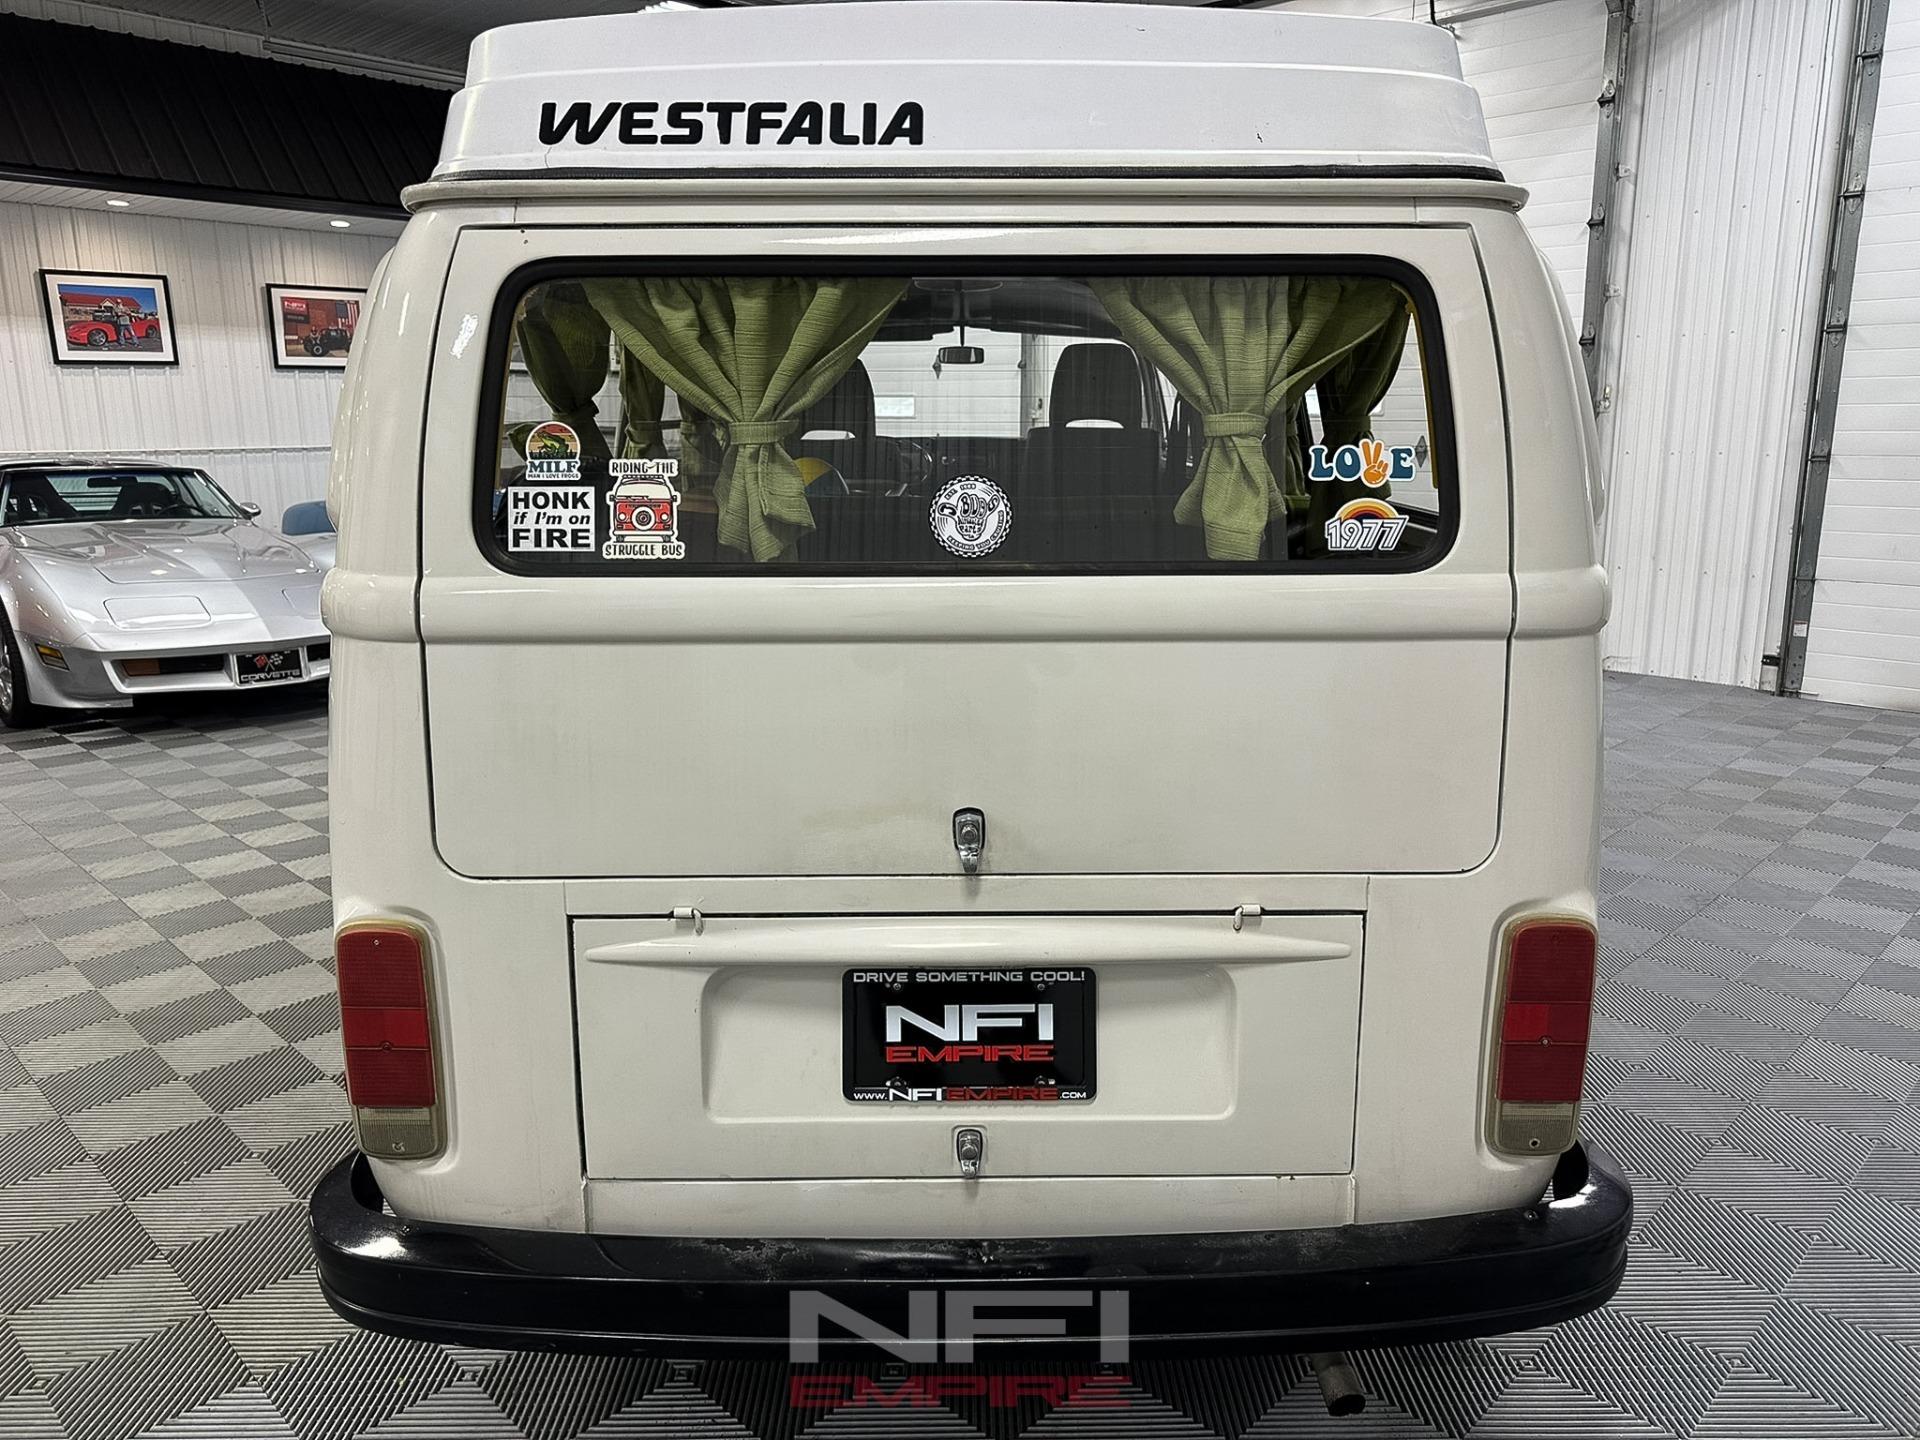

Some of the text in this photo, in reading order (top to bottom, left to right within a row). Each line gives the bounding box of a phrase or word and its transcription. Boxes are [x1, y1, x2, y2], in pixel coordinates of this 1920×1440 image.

[539, 101, 923, 145] WESTFALIA
[529, 461, 578, 473] MILF
[612, 462, 675, 473] RIDING THE
[1310, 441, 1414, 484] LOVE
[512, 492, 590, 510] HONK
[513, 512, 590, 524] if I'm on
[512, 529, 591, 548] FIRE
[1327, 517, 1407, 549] 1977
[605, 544, 682, 556] STRUGGLE BUS
[240, 669, 300, 682] CORVETTE
[853, 971, 1085, 983] DRIVE SOMETHING COOL!
[886, 1003, 1054, 1042] NFI
[886, 1044, 1054, 1063] EMPIRE
